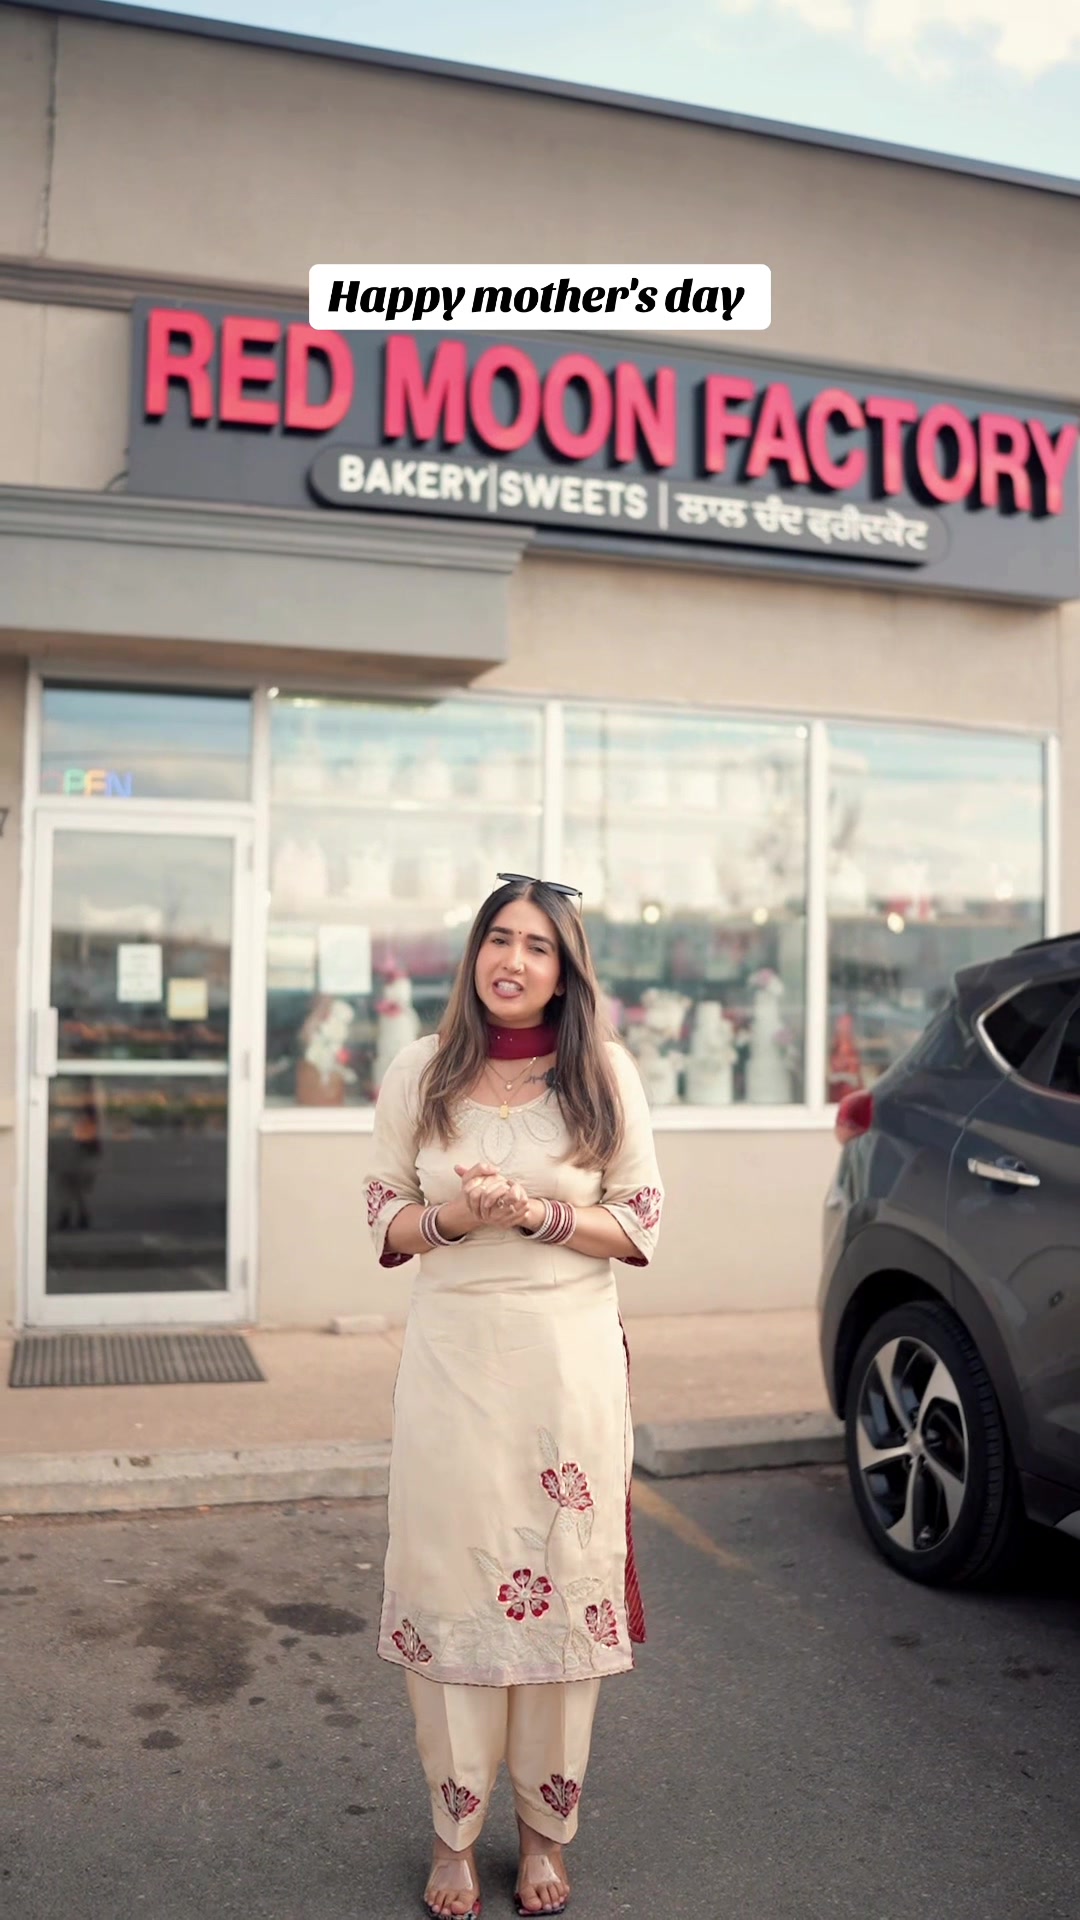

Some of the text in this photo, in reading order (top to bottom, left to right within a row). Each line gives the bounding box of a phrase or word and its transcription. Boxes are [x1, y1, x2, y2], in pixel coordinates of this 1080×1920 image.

[145, 308, 1079, 515] RED MOON FACTORY
[338, 453, 648, 520] BAKERY SWEETS
[673, 492, 749, 529] ਲਾਲ
